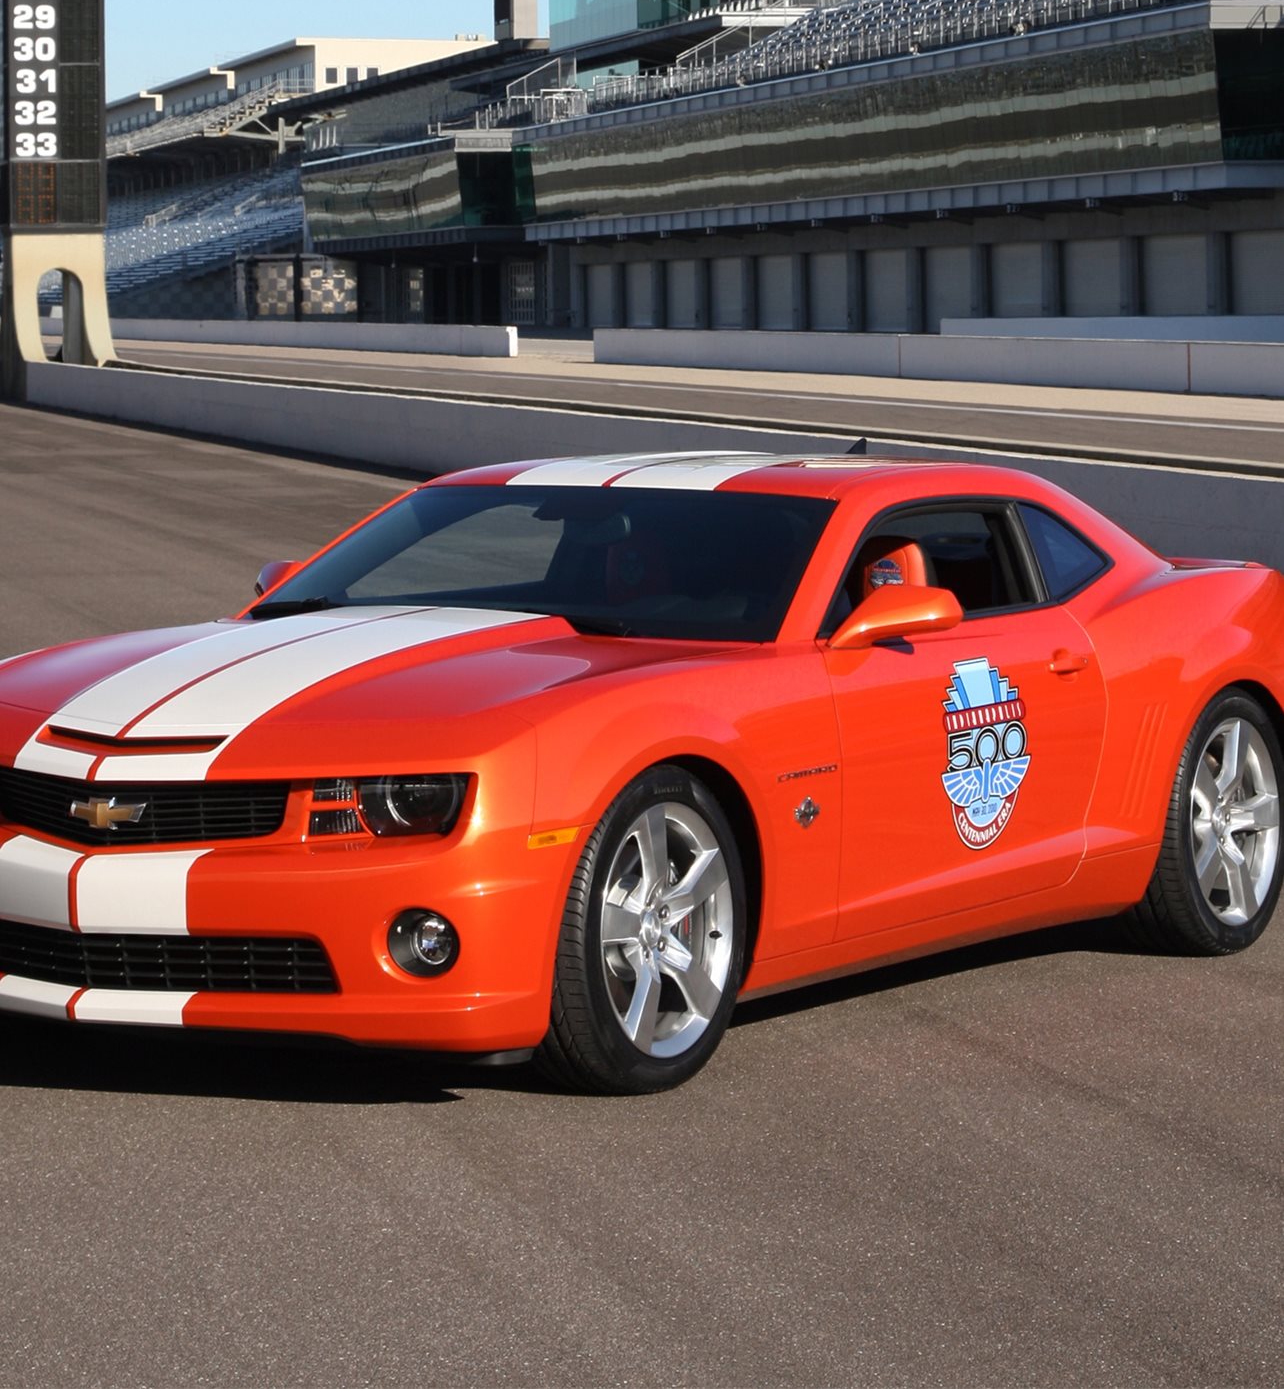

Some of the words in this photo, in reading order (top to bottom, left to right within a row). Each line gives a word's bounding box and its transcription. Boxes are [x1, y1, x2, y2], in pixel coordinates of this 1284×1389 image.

[12, 3, 56, 30] 29
[13, 36, 57, 62] 30
[15, 68, 57, 94] 31
[14, 99, 57, 126] 32
[14, 131, 58, 159] 33
[945, 701, 1022, 732] INDIANAPOLIS
[947, 720, 1027, 772] 500
[958, 812, 998, 843] CENTENNIAL
[998, 802, 1012, 827] ERA
